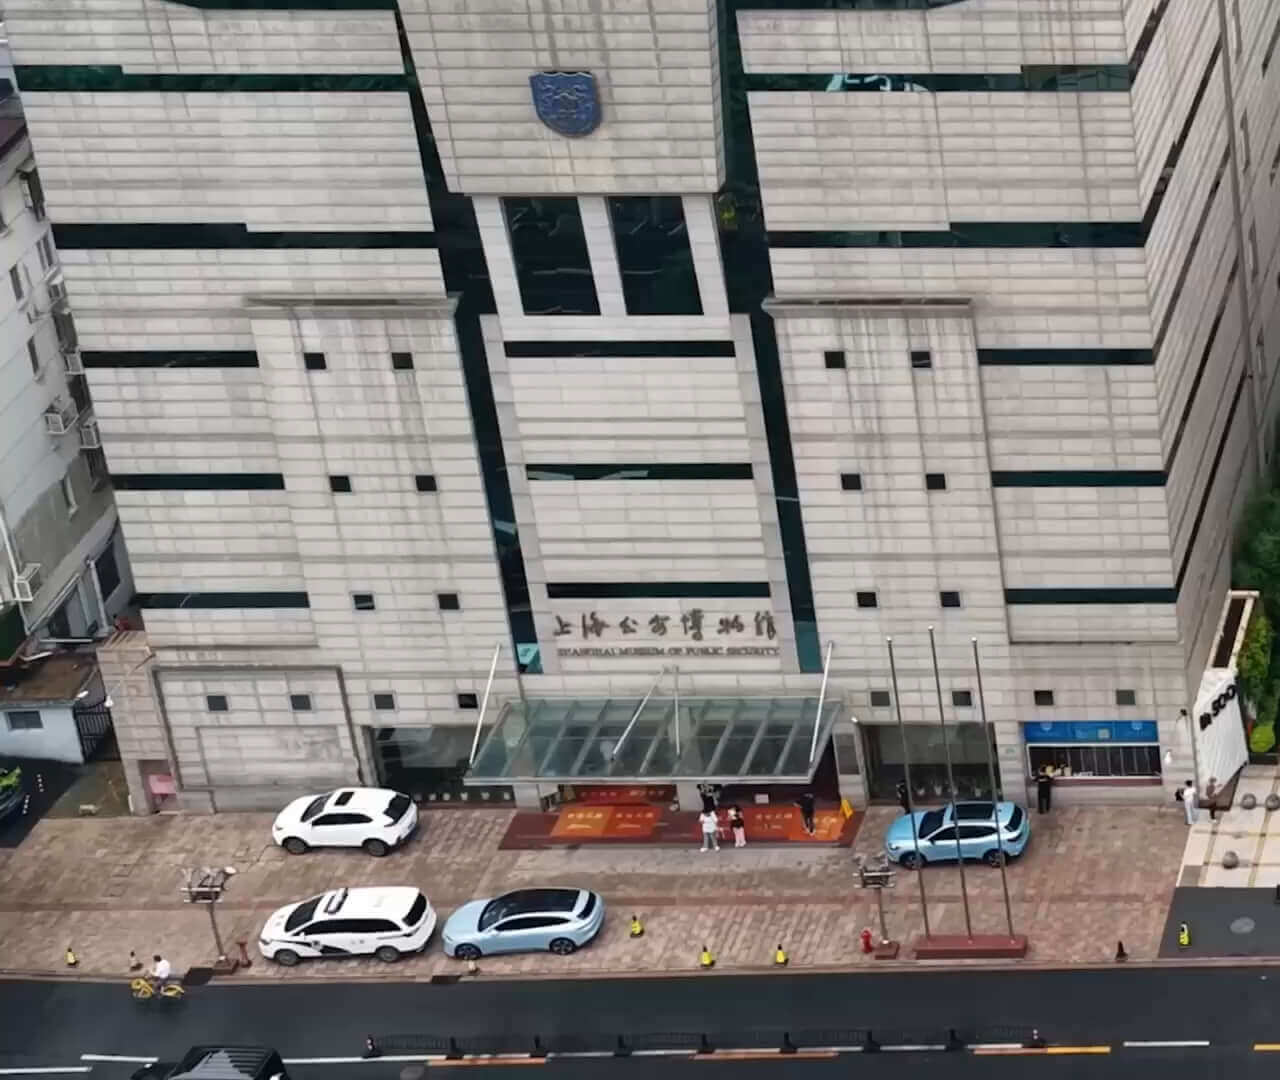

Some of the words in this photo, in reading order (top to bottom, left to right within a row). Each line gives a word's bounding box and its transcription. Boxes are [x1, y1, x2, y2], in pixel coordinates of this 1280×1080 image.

[618, 647, 665, 657] MUSEUM
[685, 647, 724, 657] PUBLIC
[727, 647, 780, 657] SECURITY
